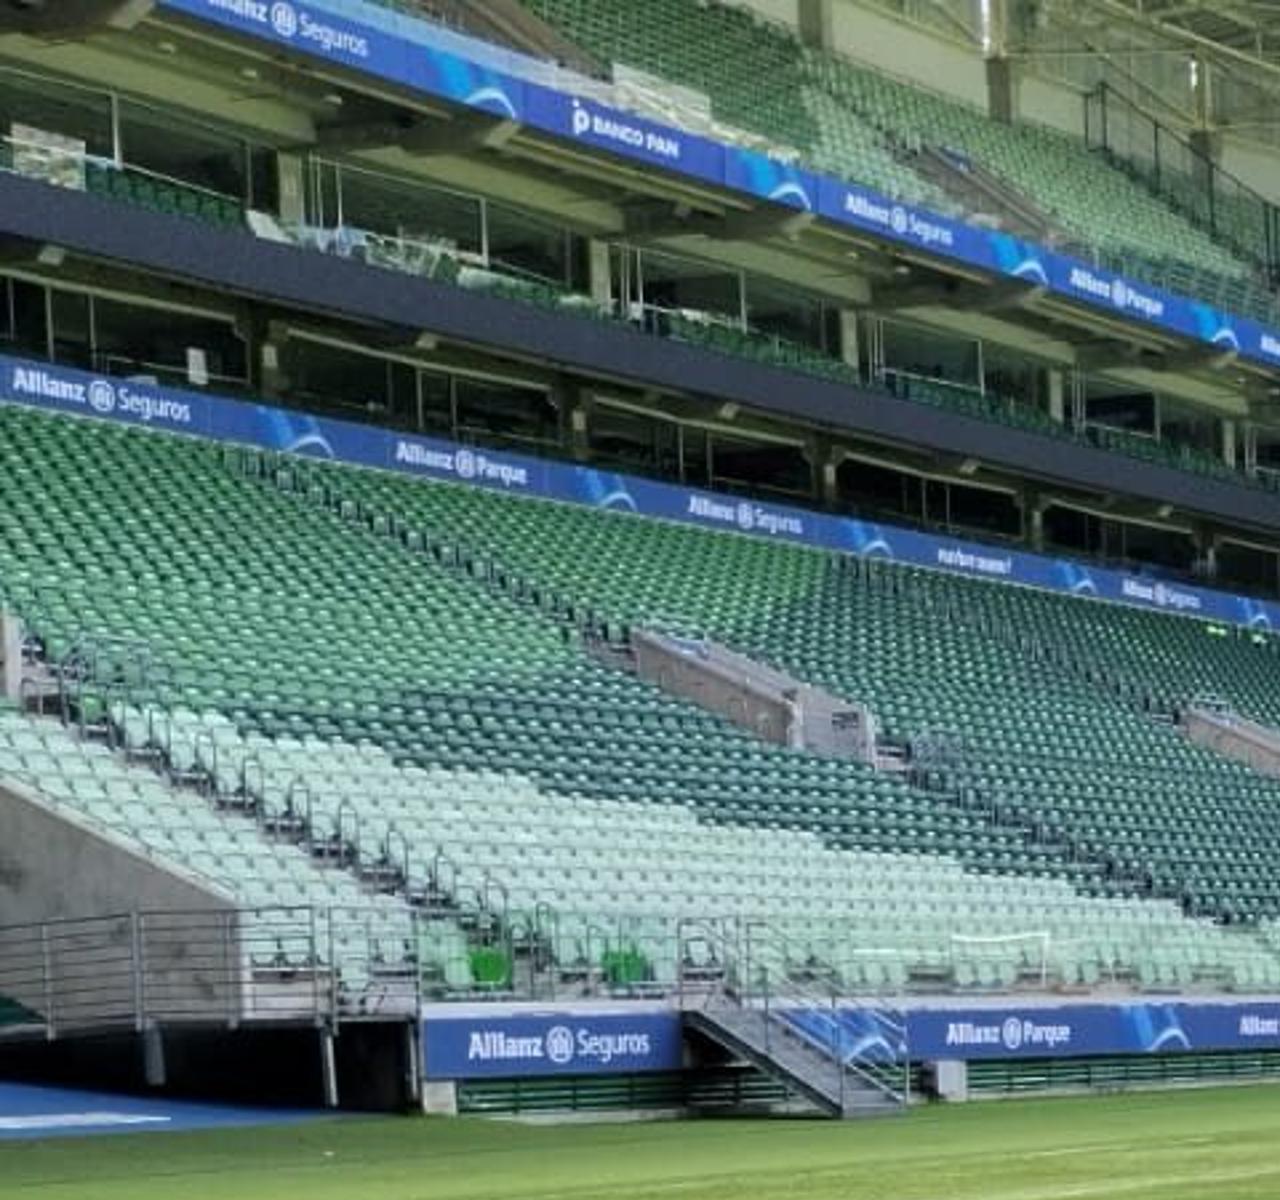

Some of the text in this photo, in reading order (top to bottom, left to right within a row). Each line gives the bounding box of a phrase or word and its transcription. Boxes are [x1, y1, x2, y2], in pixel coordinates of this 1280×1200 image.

[300, 12, 368, 57] Seguros
[594, 115, 679, 158] BANCO PAN
[845, 192, 954, 246] Allianz Seguros
[1070, 267, 1164, 317] Allianz Parque
[13, 366, 191, 422] Allianz Seguros
[396, 441, 527, 487] Allianz Parque
[689, 494, 803, 535] Allianz Seguros
[468, 1028, 651, 1063] Allianz Seguros
[945, 1020, 1071, 1048] Allianz Parque
[1240, 1014, 1278, 1036] Allianz
